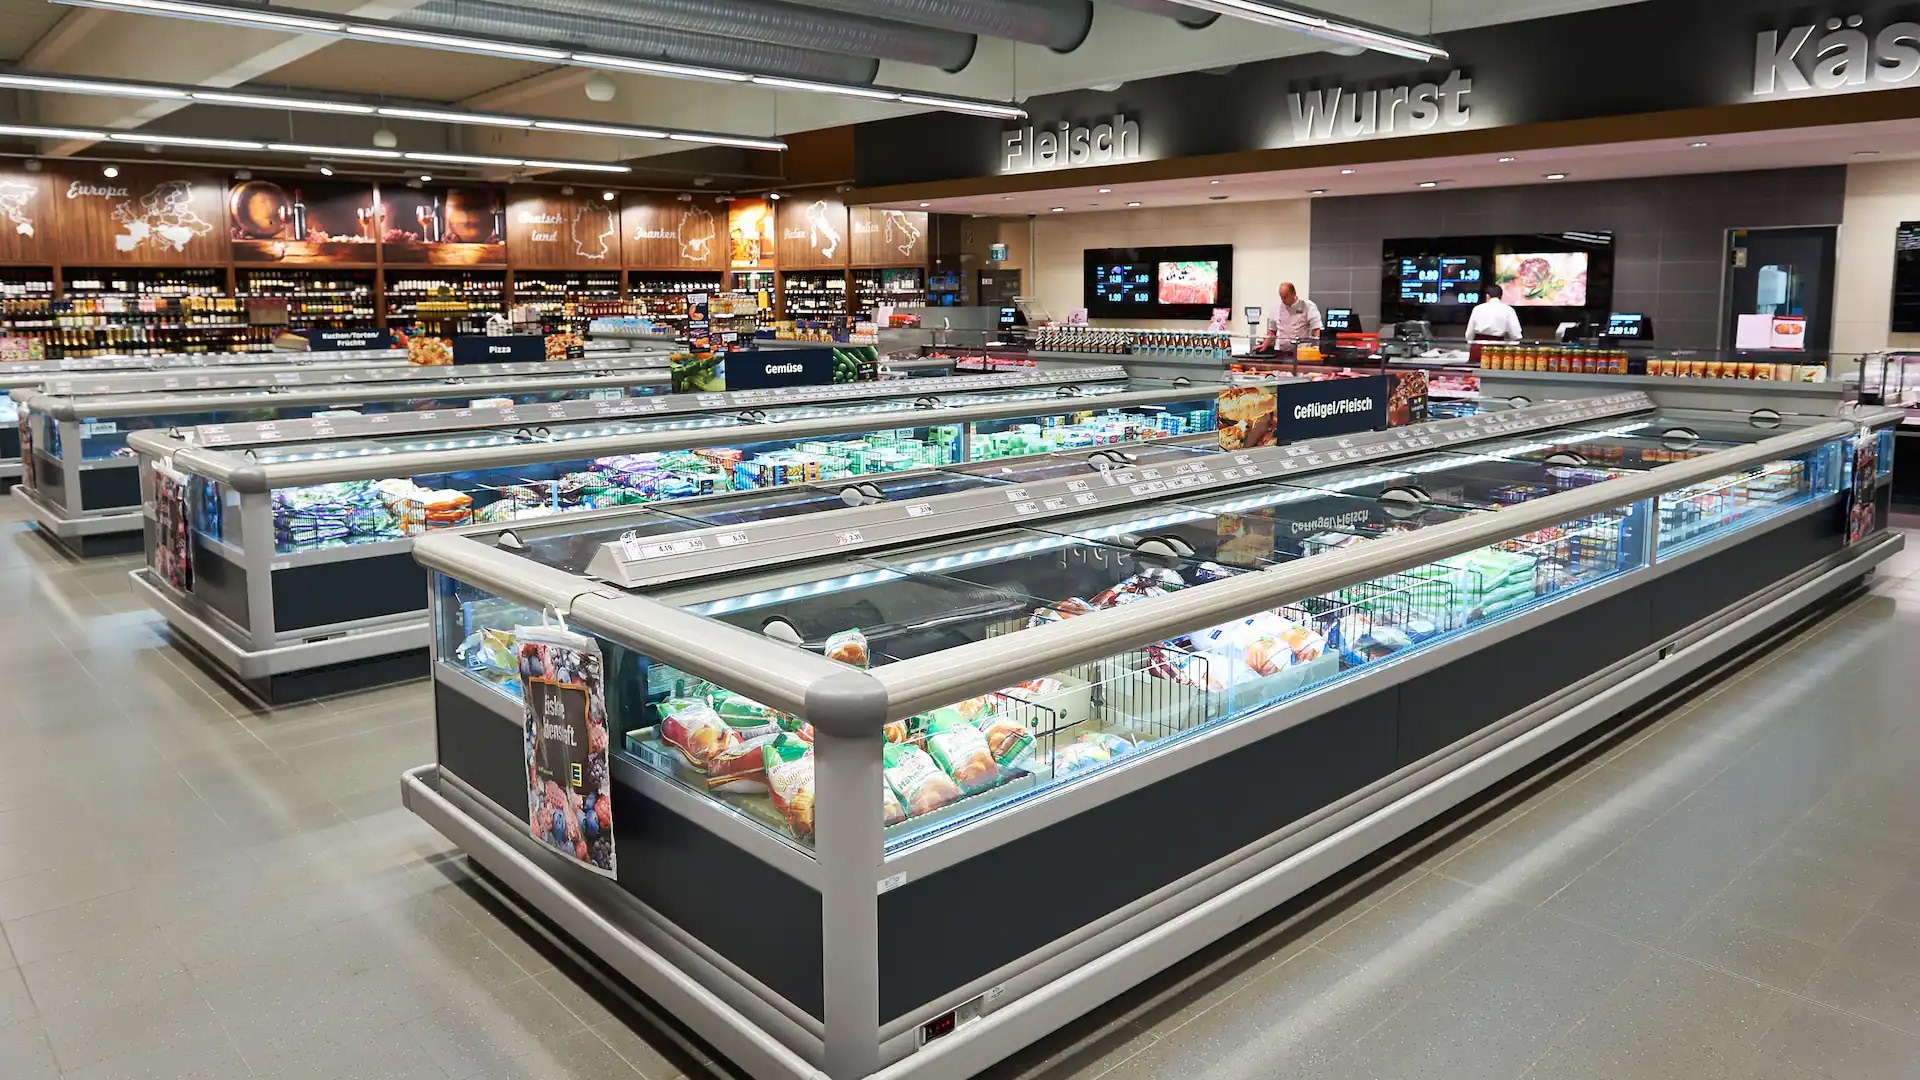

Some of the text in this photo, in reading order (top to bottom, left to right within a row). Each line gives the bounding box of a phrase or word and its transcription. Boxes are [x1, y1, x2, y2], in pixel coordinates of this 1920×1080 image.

[1287, 68, 1473, 142] Wurst
[1000, 113, 1142, 171] Fleisch
[66, 180, 129, 200] Europa
[531, 229, 558, 242] land
[634, 226, 677, 240] Franken
[322, 331, 380, 341] Kuchen/Torten/
[336, 339, 367, 348] Früchte
[488, 345, 512, 355] Pizza
[765, 362, 804, 376] Gemüse
[1294, 396, 1373, 420] Geflügel/Fleisch
